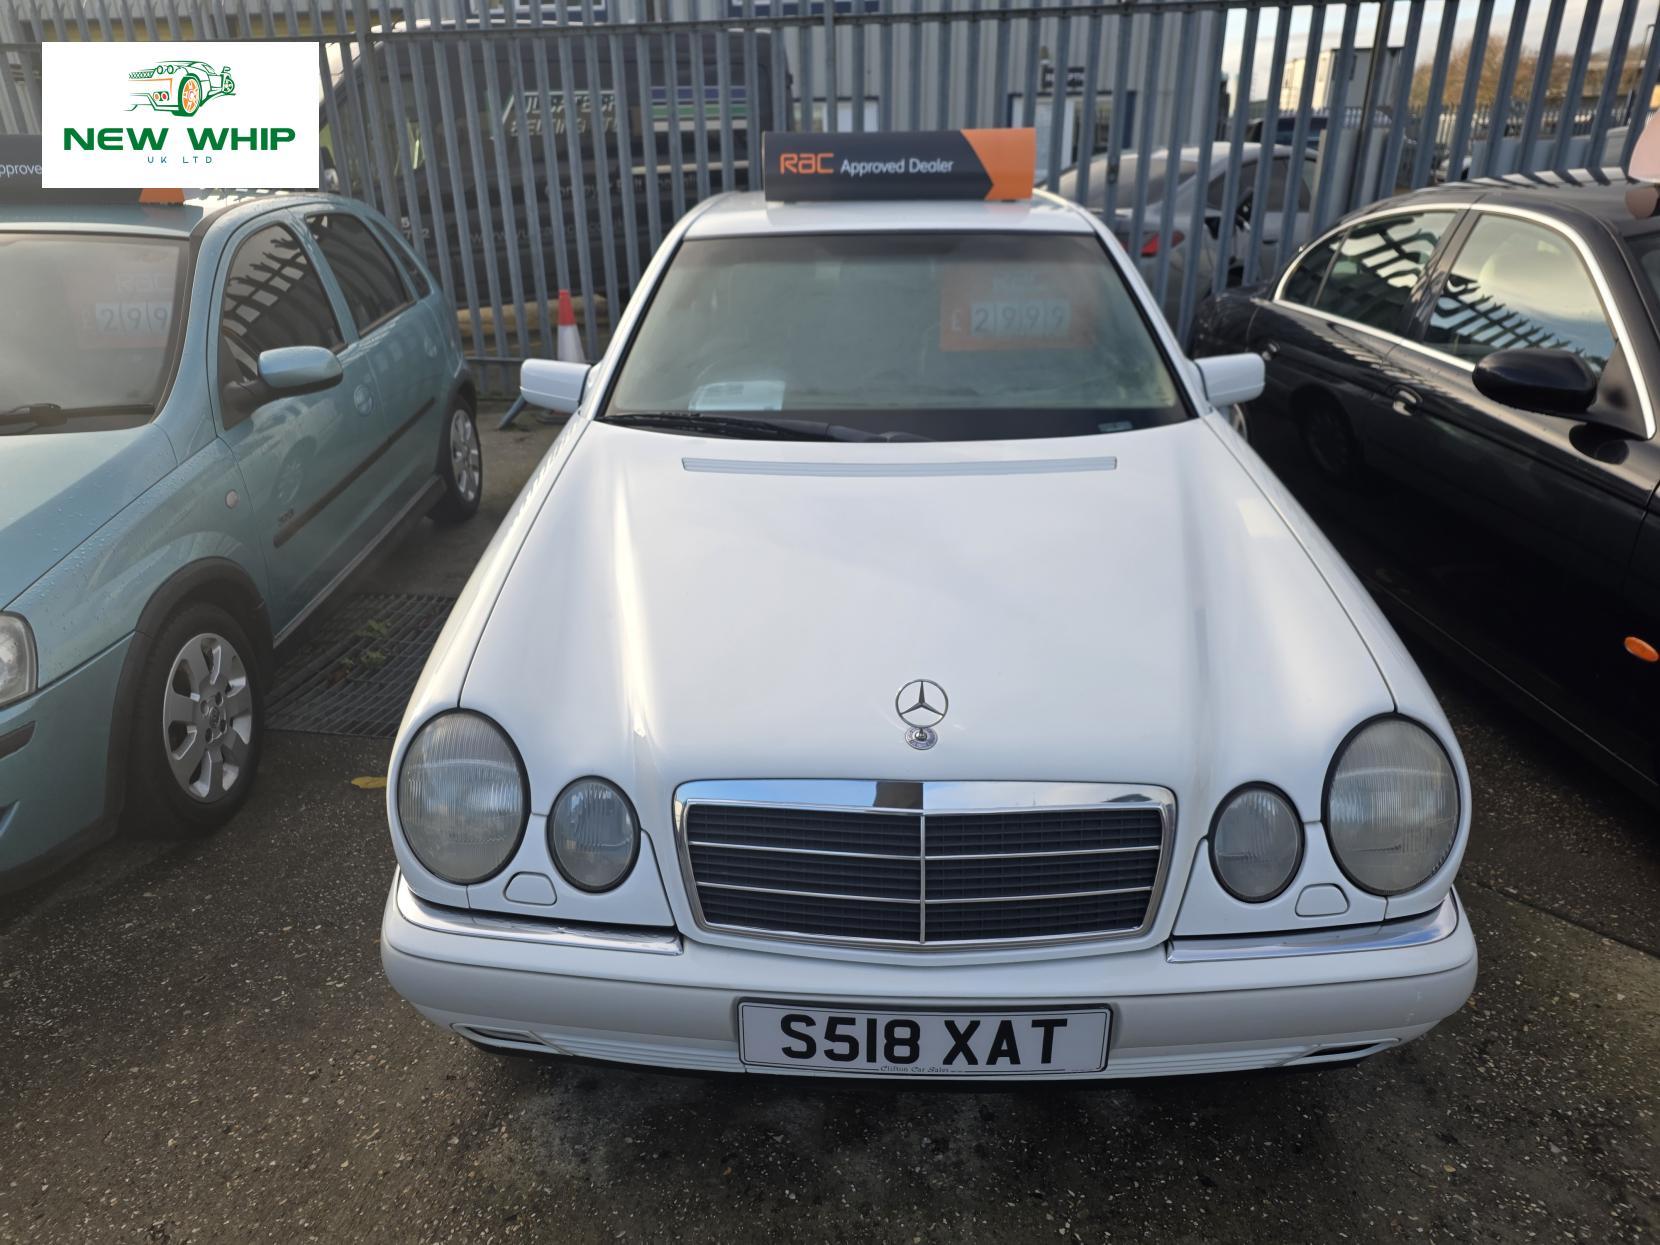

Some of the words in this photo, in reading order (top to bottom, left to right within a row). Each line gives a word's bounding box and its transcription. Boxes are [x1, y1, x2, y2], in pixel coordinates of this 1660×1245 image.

[840, 160, 904, 177] Approved
[908, 159, 954, 173] Dealer
[780, 1013, 921, 1065] S518
[942, 1018, 1068, 1065] XAT
